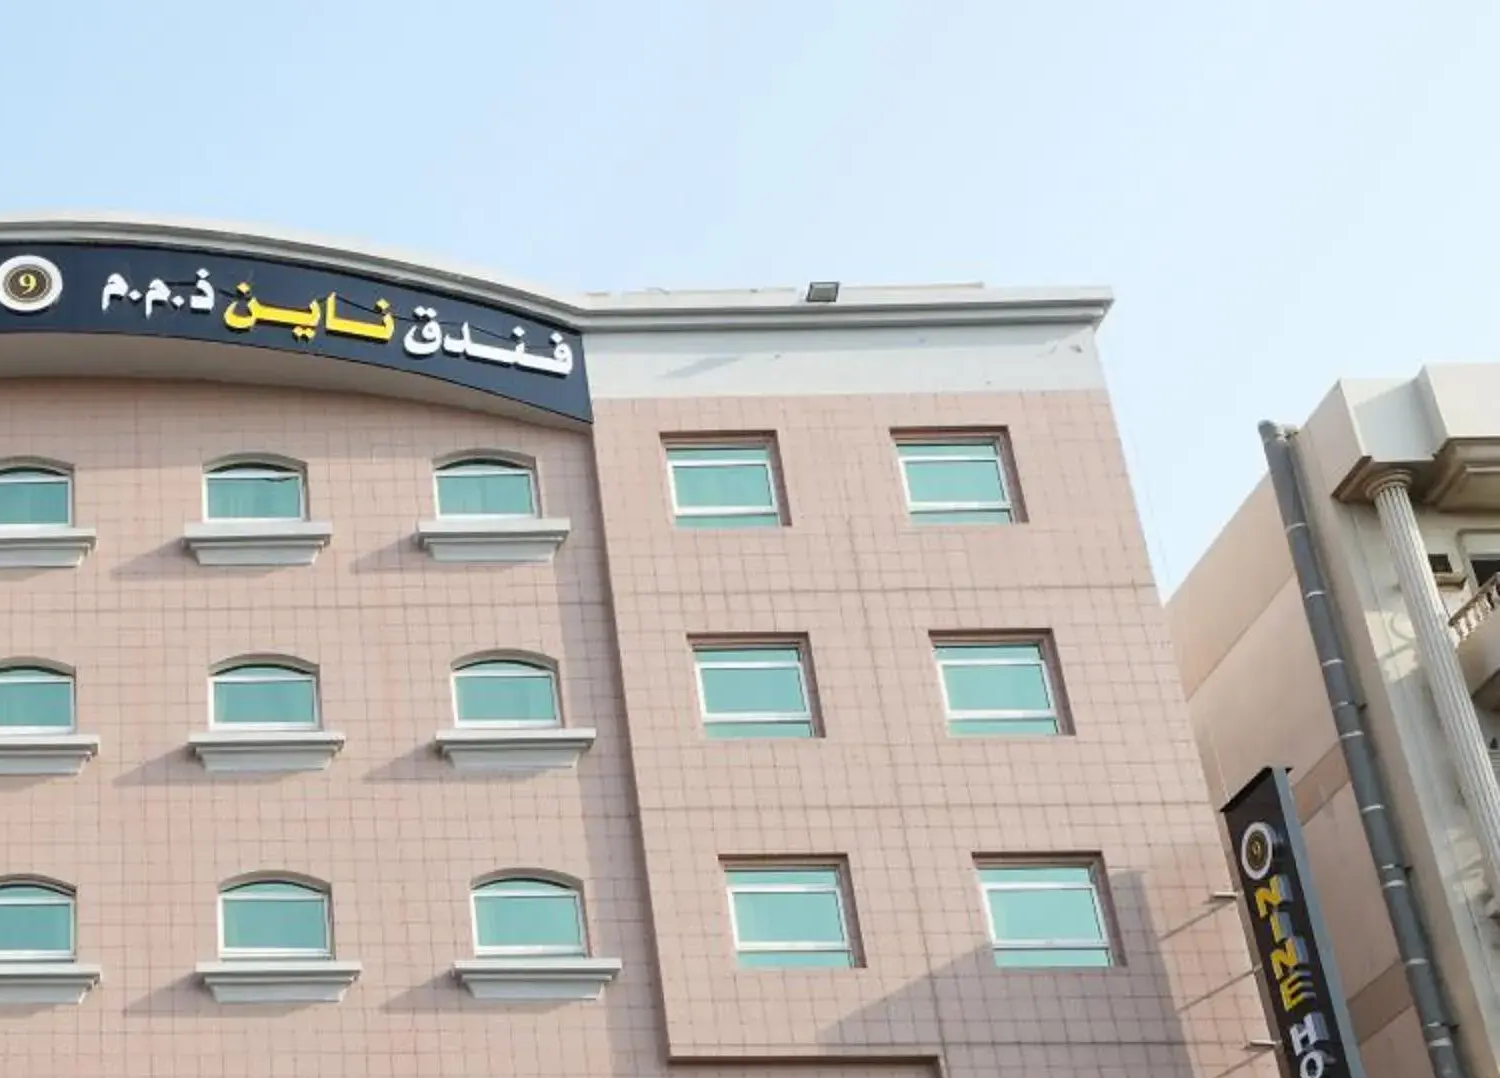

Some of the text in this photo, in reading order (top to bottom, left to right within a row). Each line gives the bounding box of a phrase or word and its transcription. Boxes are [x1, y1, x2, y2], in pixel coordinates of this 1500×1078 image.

[19, 273, 37, 295] 9
[223, 281, 394, 339] ناين
[404, 305, 573, 376] فندق
[1255, 875, 1308, 1012] NINE
